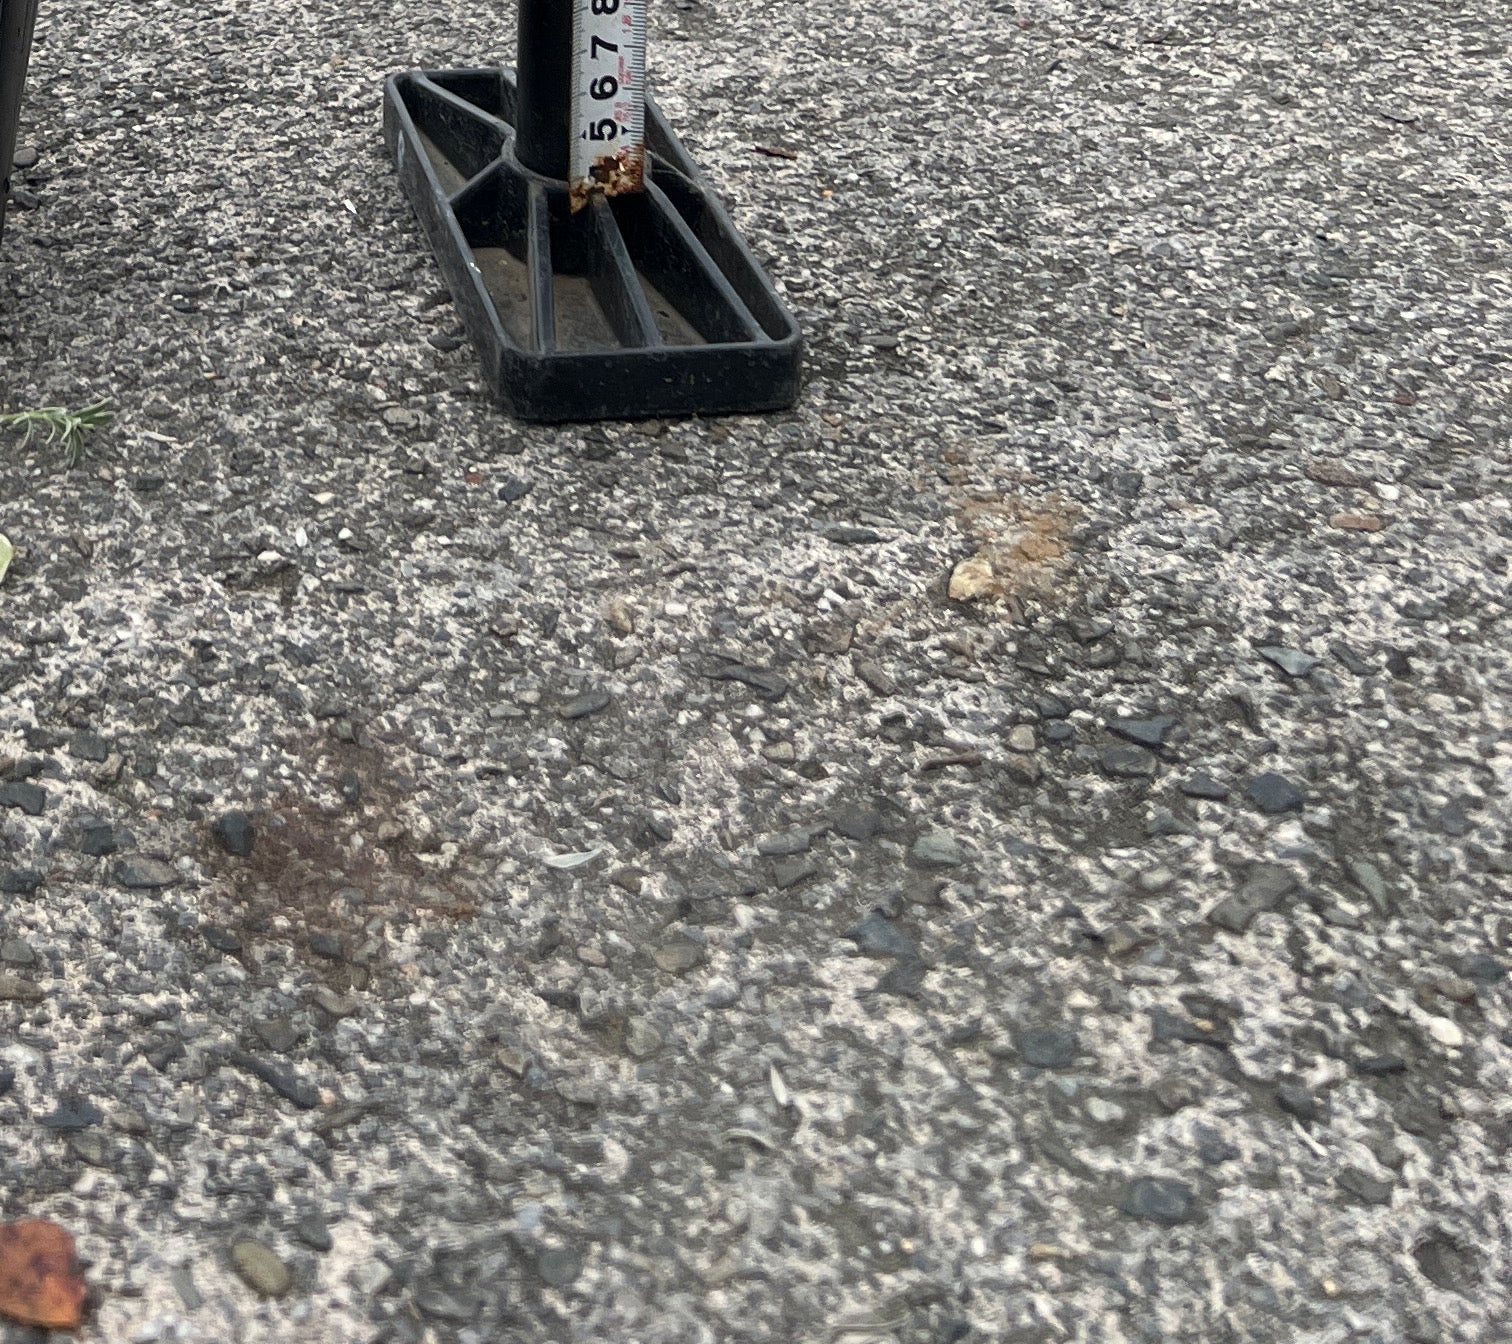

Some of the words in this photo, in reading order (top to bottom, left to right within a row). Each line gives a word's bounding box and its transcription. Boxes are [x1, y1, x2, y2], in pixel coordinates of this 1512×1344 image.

[590, 35, 619, 60] 7
[589, 75, 619, 101] 6
[589, 118, 618, 142] 5
